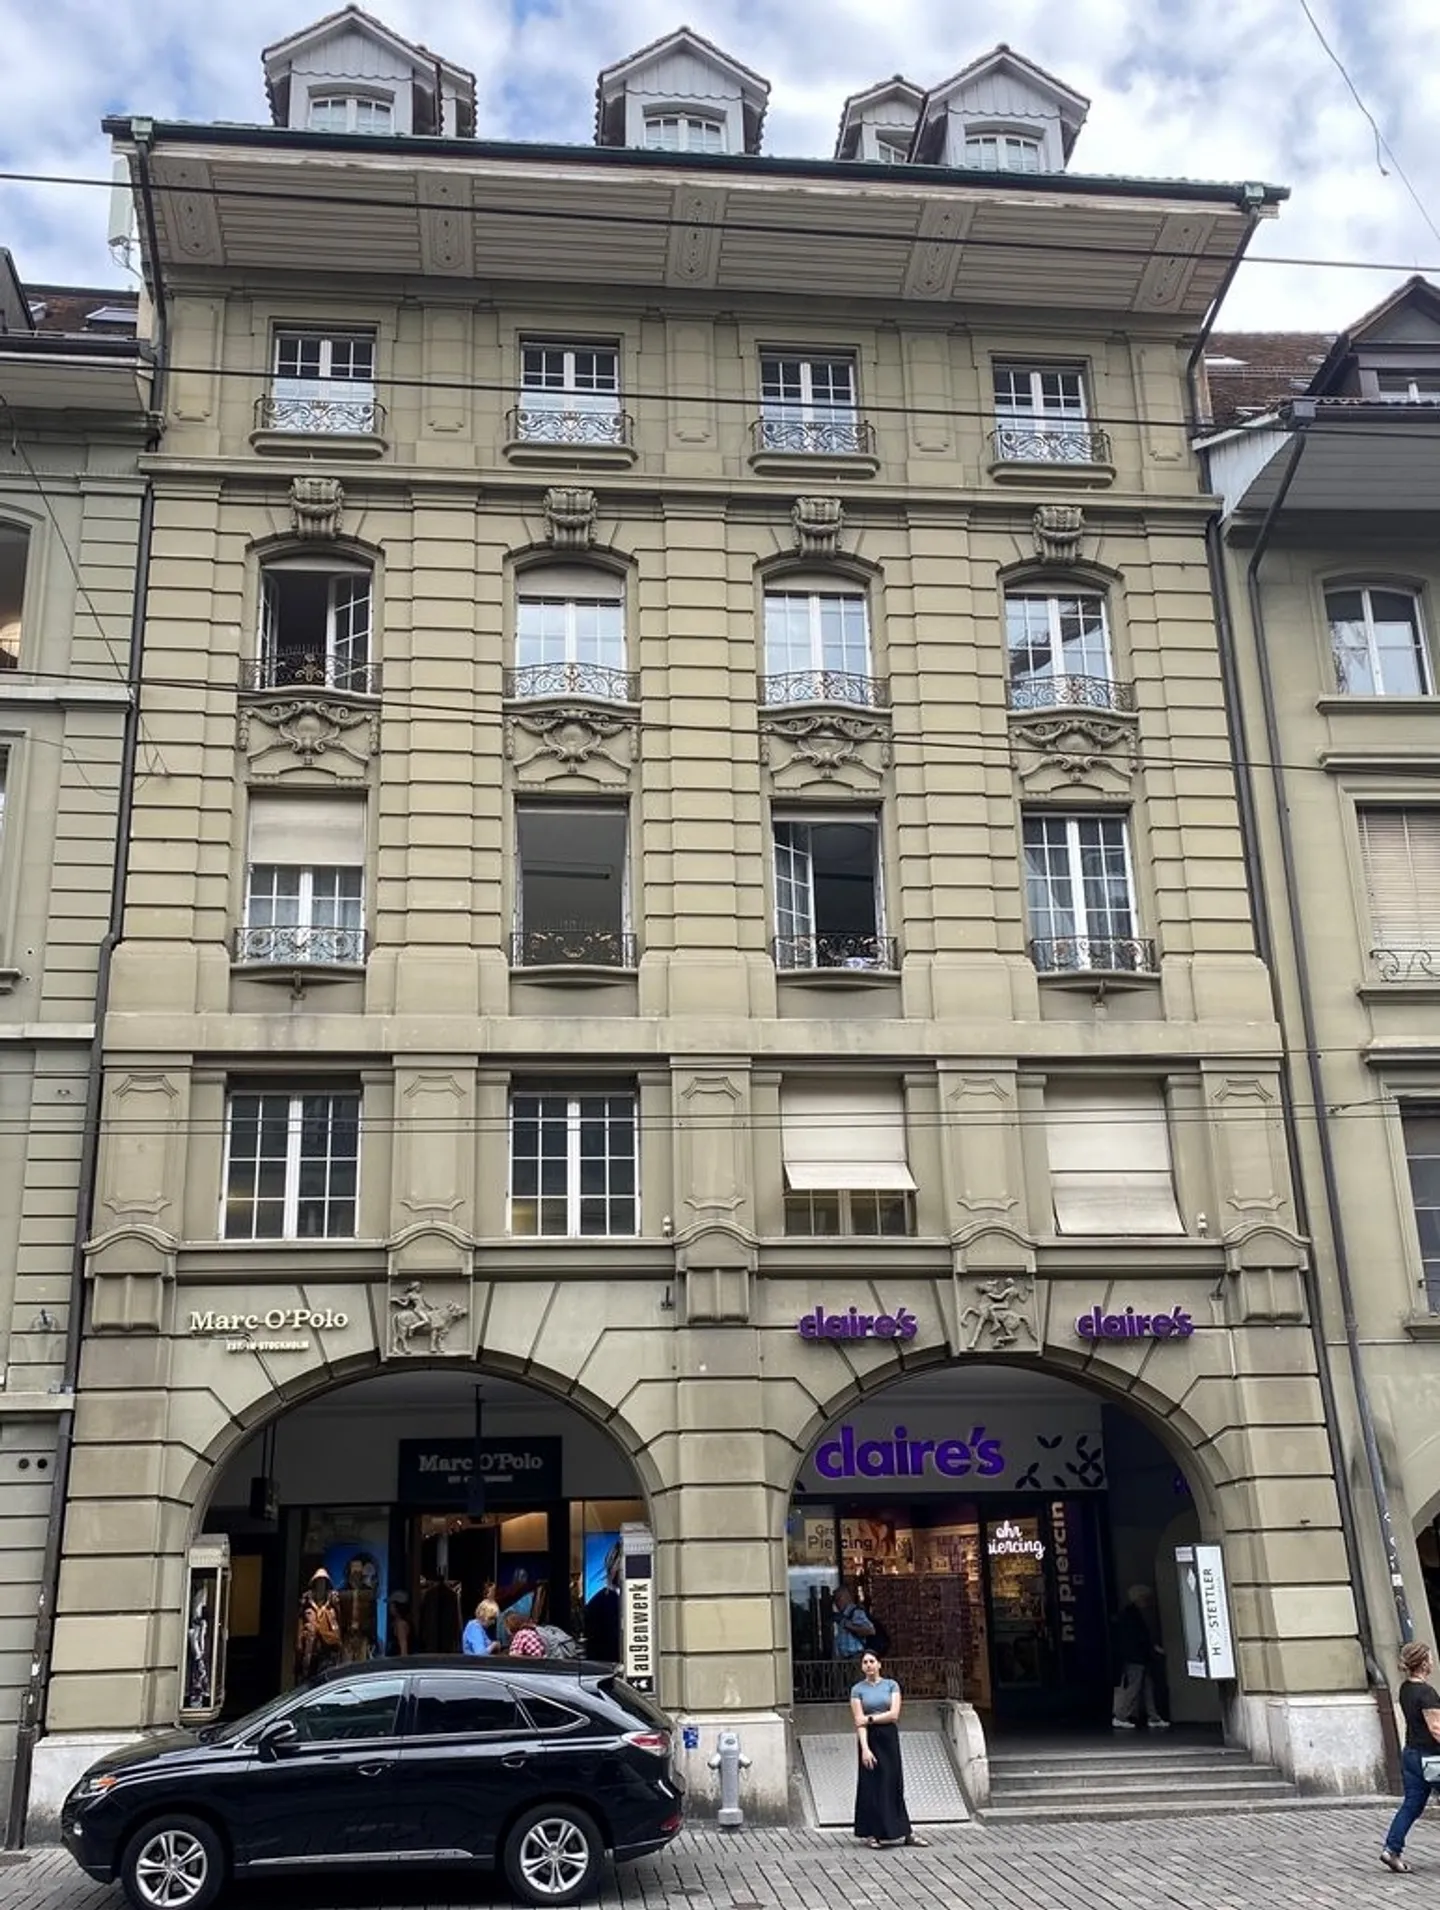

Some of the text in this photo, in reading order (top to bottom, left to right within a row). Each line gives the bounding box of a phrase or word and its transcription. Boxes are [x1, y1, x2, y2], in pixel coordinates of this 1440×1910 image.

[189, 1308, 349, 1330] Marc O'Polo
[798, 1305, 919, 1339] claire's
[1075, 1305, 1195, 1339] claire's
[417, 1452, 544, 1473] Marc O'Polo
[815, 1424, 1006, 1479] claire's
[808, 1535, 873, 1551] Piecing
[815, 1524, 852, 1536] Grais
[628, 1583, 649, 1672] augenwerk
[1203, 1568, 1222, 1656] HSTETTLER
